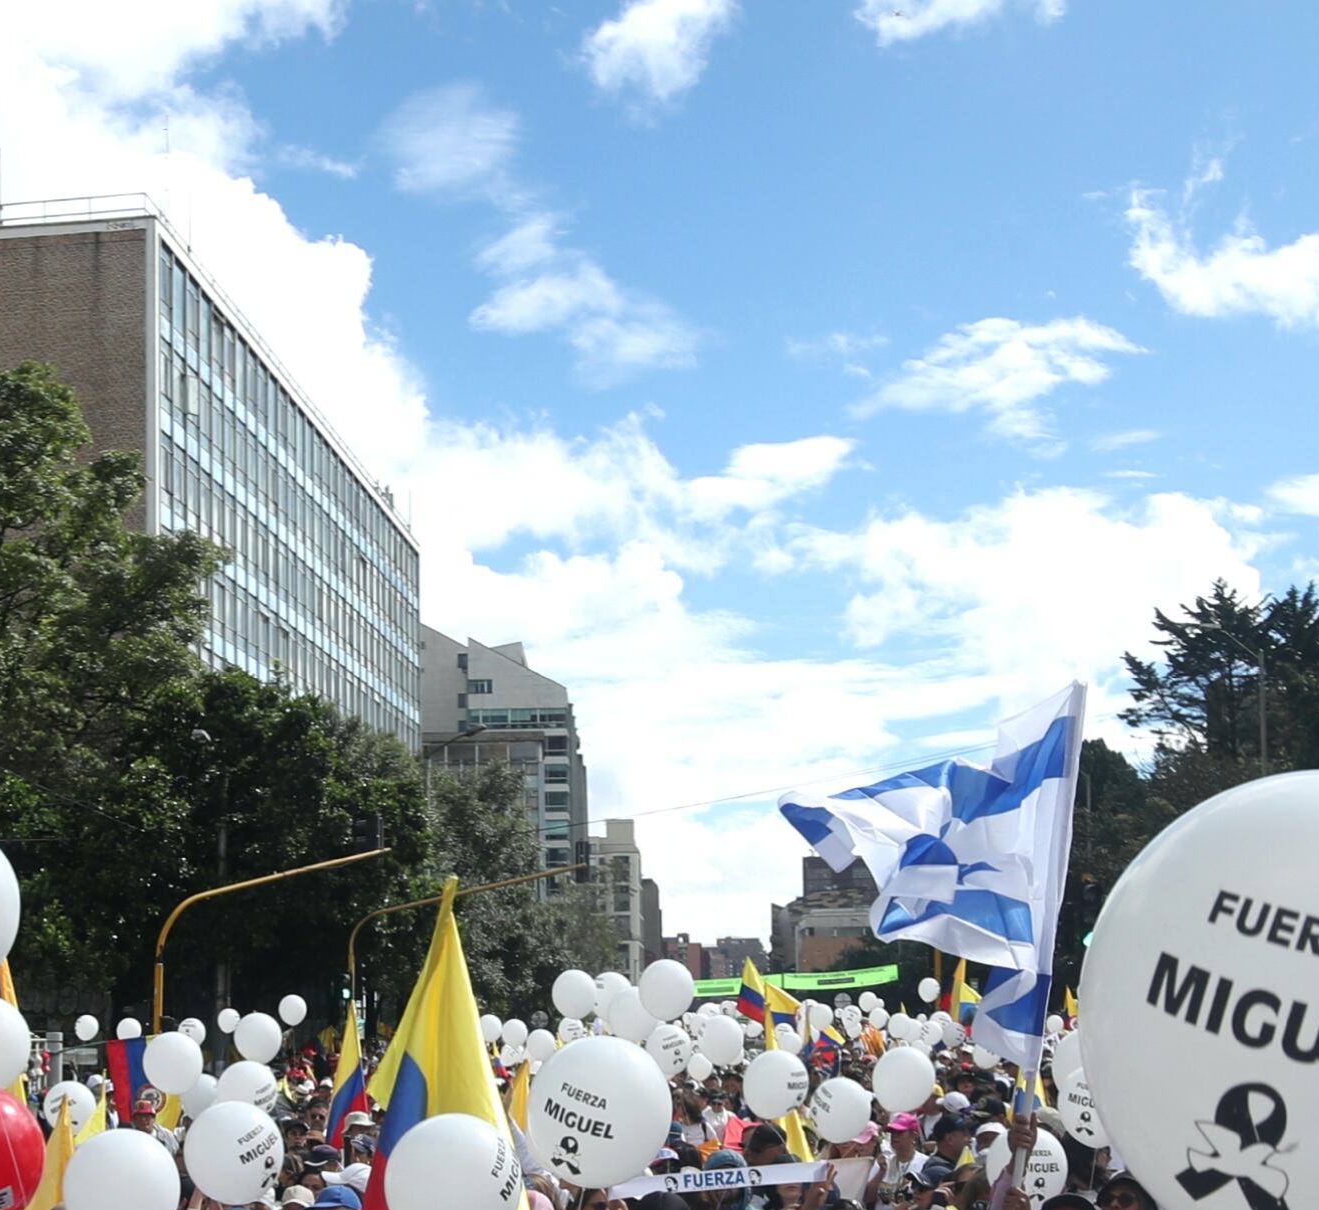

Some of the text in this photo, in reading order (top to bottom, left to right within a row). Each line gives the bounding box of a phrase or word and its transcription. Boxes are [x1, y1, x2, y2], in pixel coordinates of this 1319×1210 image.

[561, 1082, 607, 1110] FUERZA
[543, 1098, 615, 1140] MIGUEL
[239, 1132, 279, 1165] MIGUEL
[683, 1170, 745, 1189] FUERZA
[1027, 1163, 1060, 1173] IGUEL
